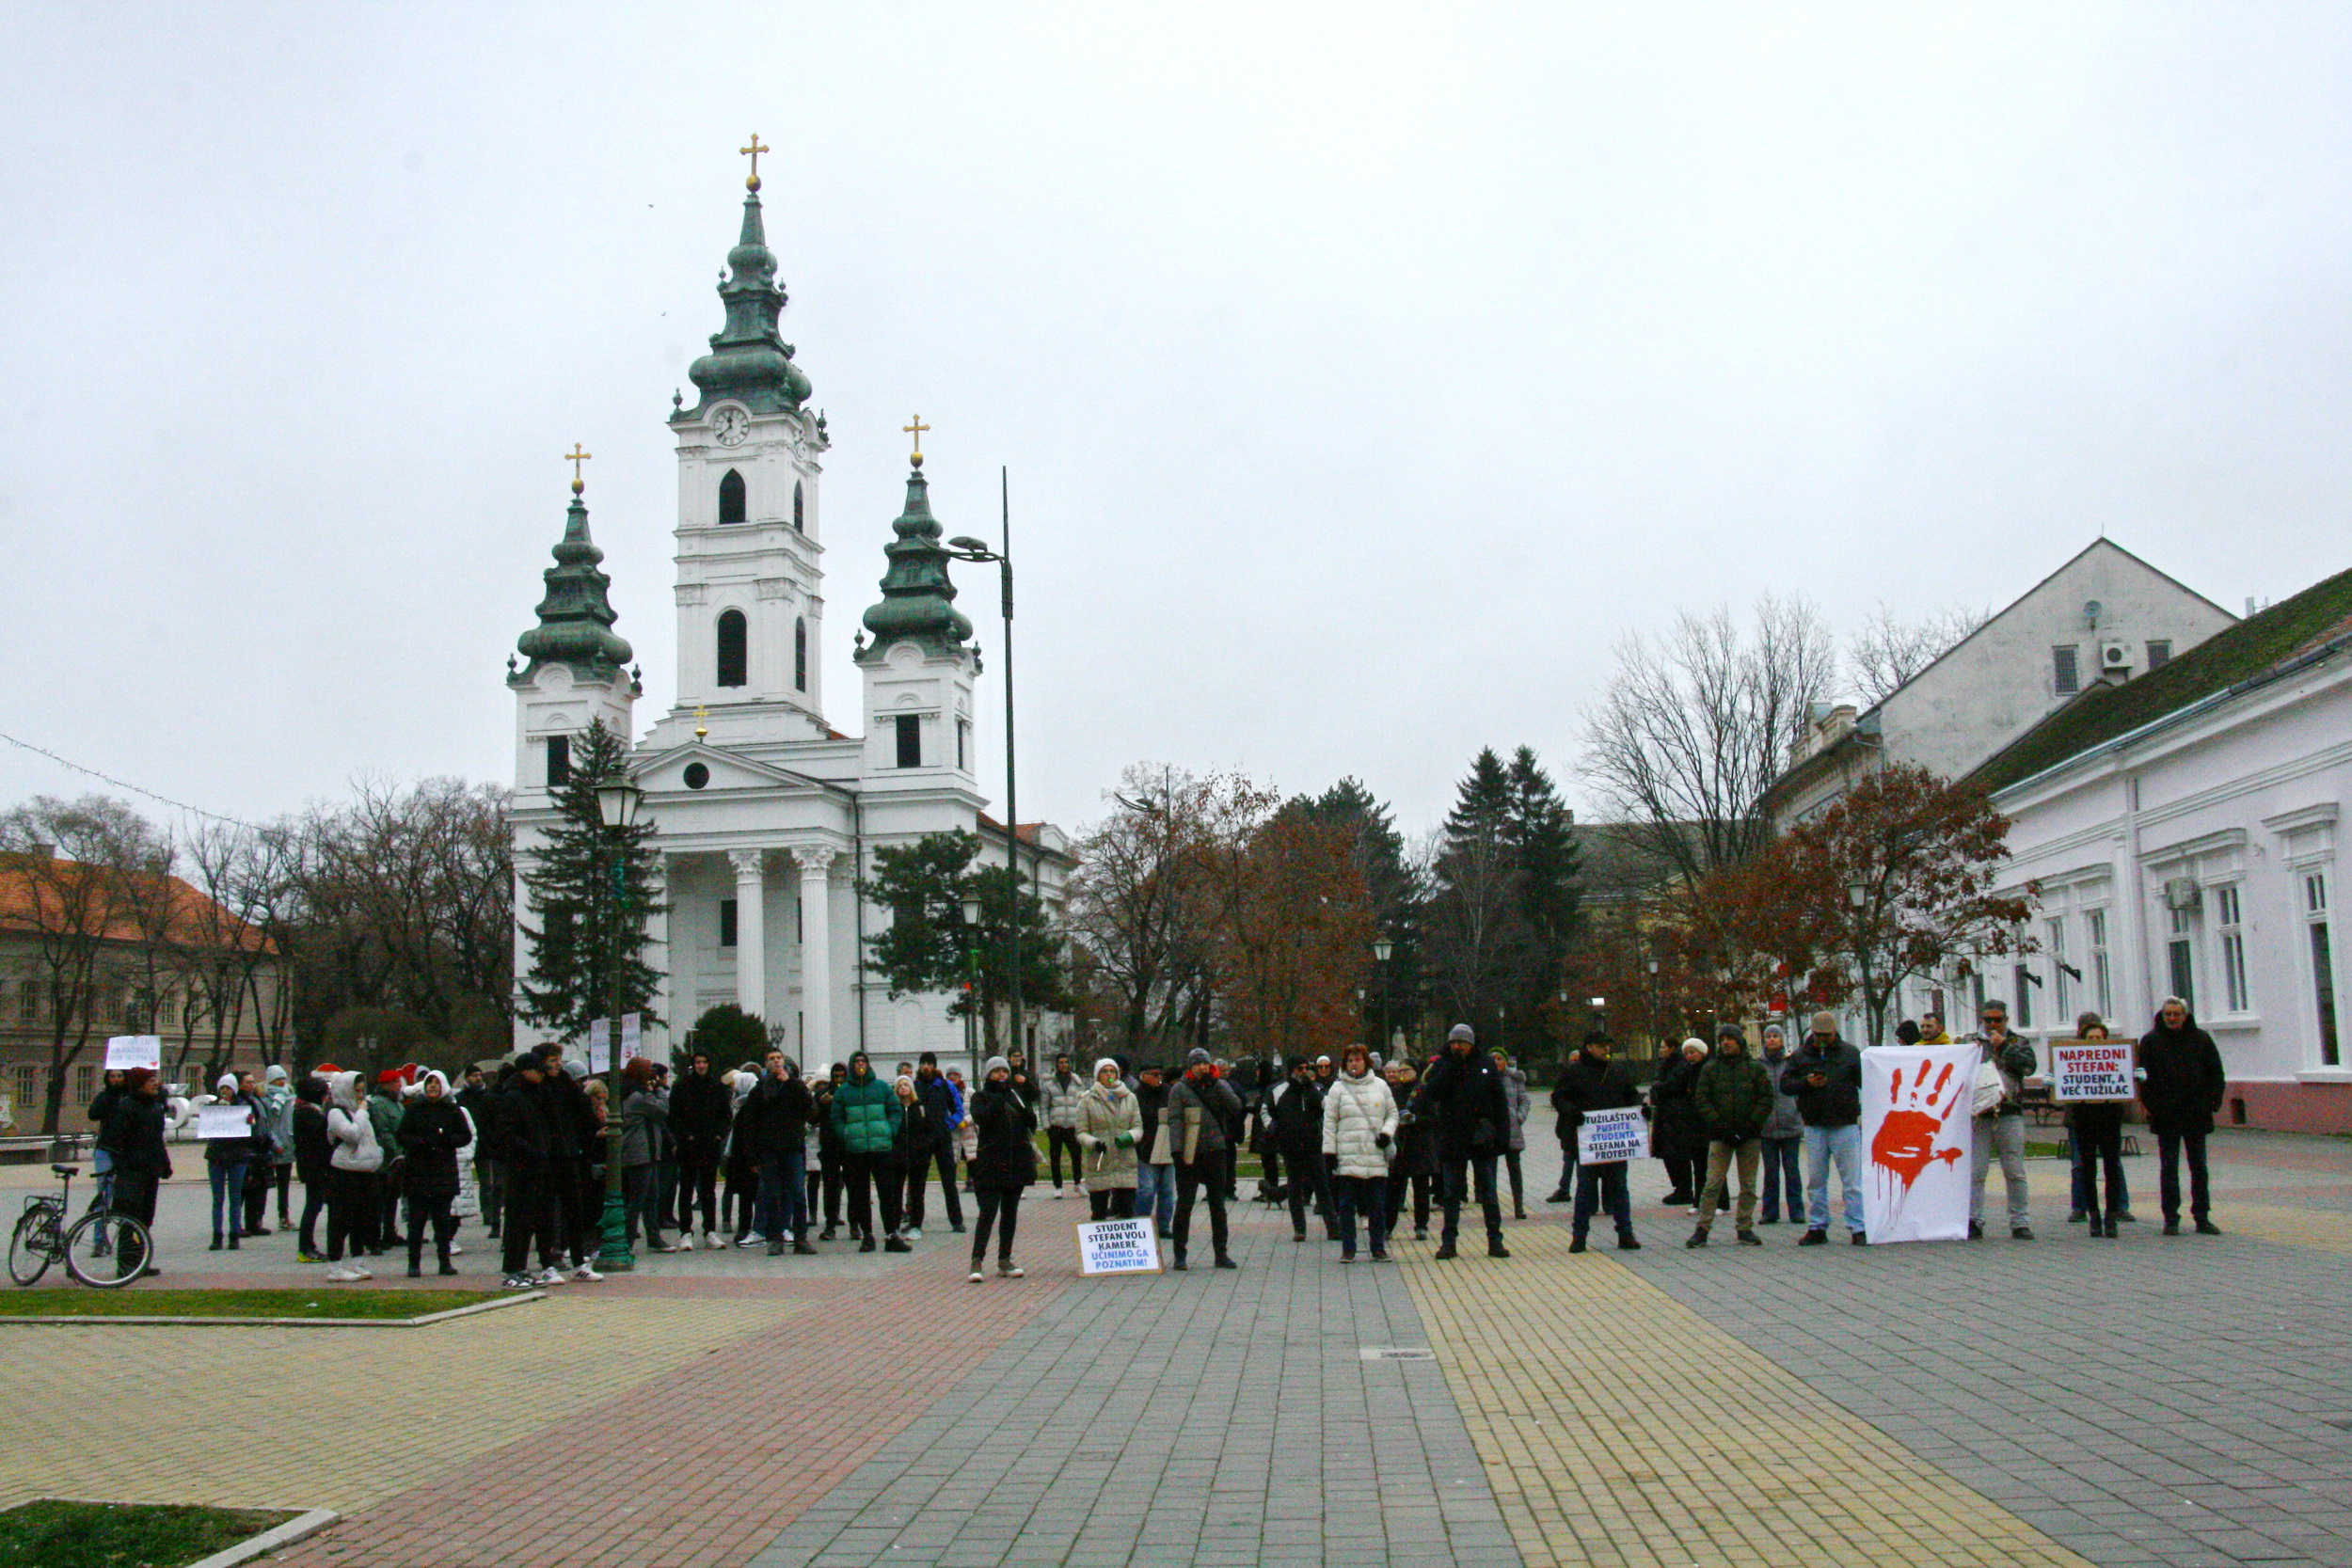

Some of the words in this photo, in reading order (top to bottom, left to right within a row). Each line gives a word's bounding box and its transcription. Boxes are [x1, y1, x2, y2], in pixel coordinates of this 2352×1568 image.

[2059, 1049, 2126, 1061] NAPREDNI
[2067, 1062, 2119, 1072] STEFAN:
[2063, 1074, 2115, 1085] STUDENT,
[2118, 1074, 2125, 1083] A
[2084, 1084, 2128, 1095] TUŽILAC
[1585, 1113, 1640, 1124] TUŽILAŠTVO,
[1596, 1122, 1630, 1132] PUSTITE
[1592, 1132, 1635, 1142] STUDENTA
[1589, 1141, 1626, 1151] STEFANA
[1629, 1139, 1640, 1148] NA
[1595, 1149, 1635, 1160] PROTEST!
[1096, 1223, 1137, 1232] STUDENT
[1089, 1233, 1122, 1243] STEFAN
[1125, 1231, 1146, 1240] VOLI
[1098, 1241, 1139, 1250] KAMERE.
[1091, 1250, 1134, 1260] UČINIMO
[1136, 1249, 1149, 1258] GA
[1095, 1259, 1147, 1269] POZNATIM!
